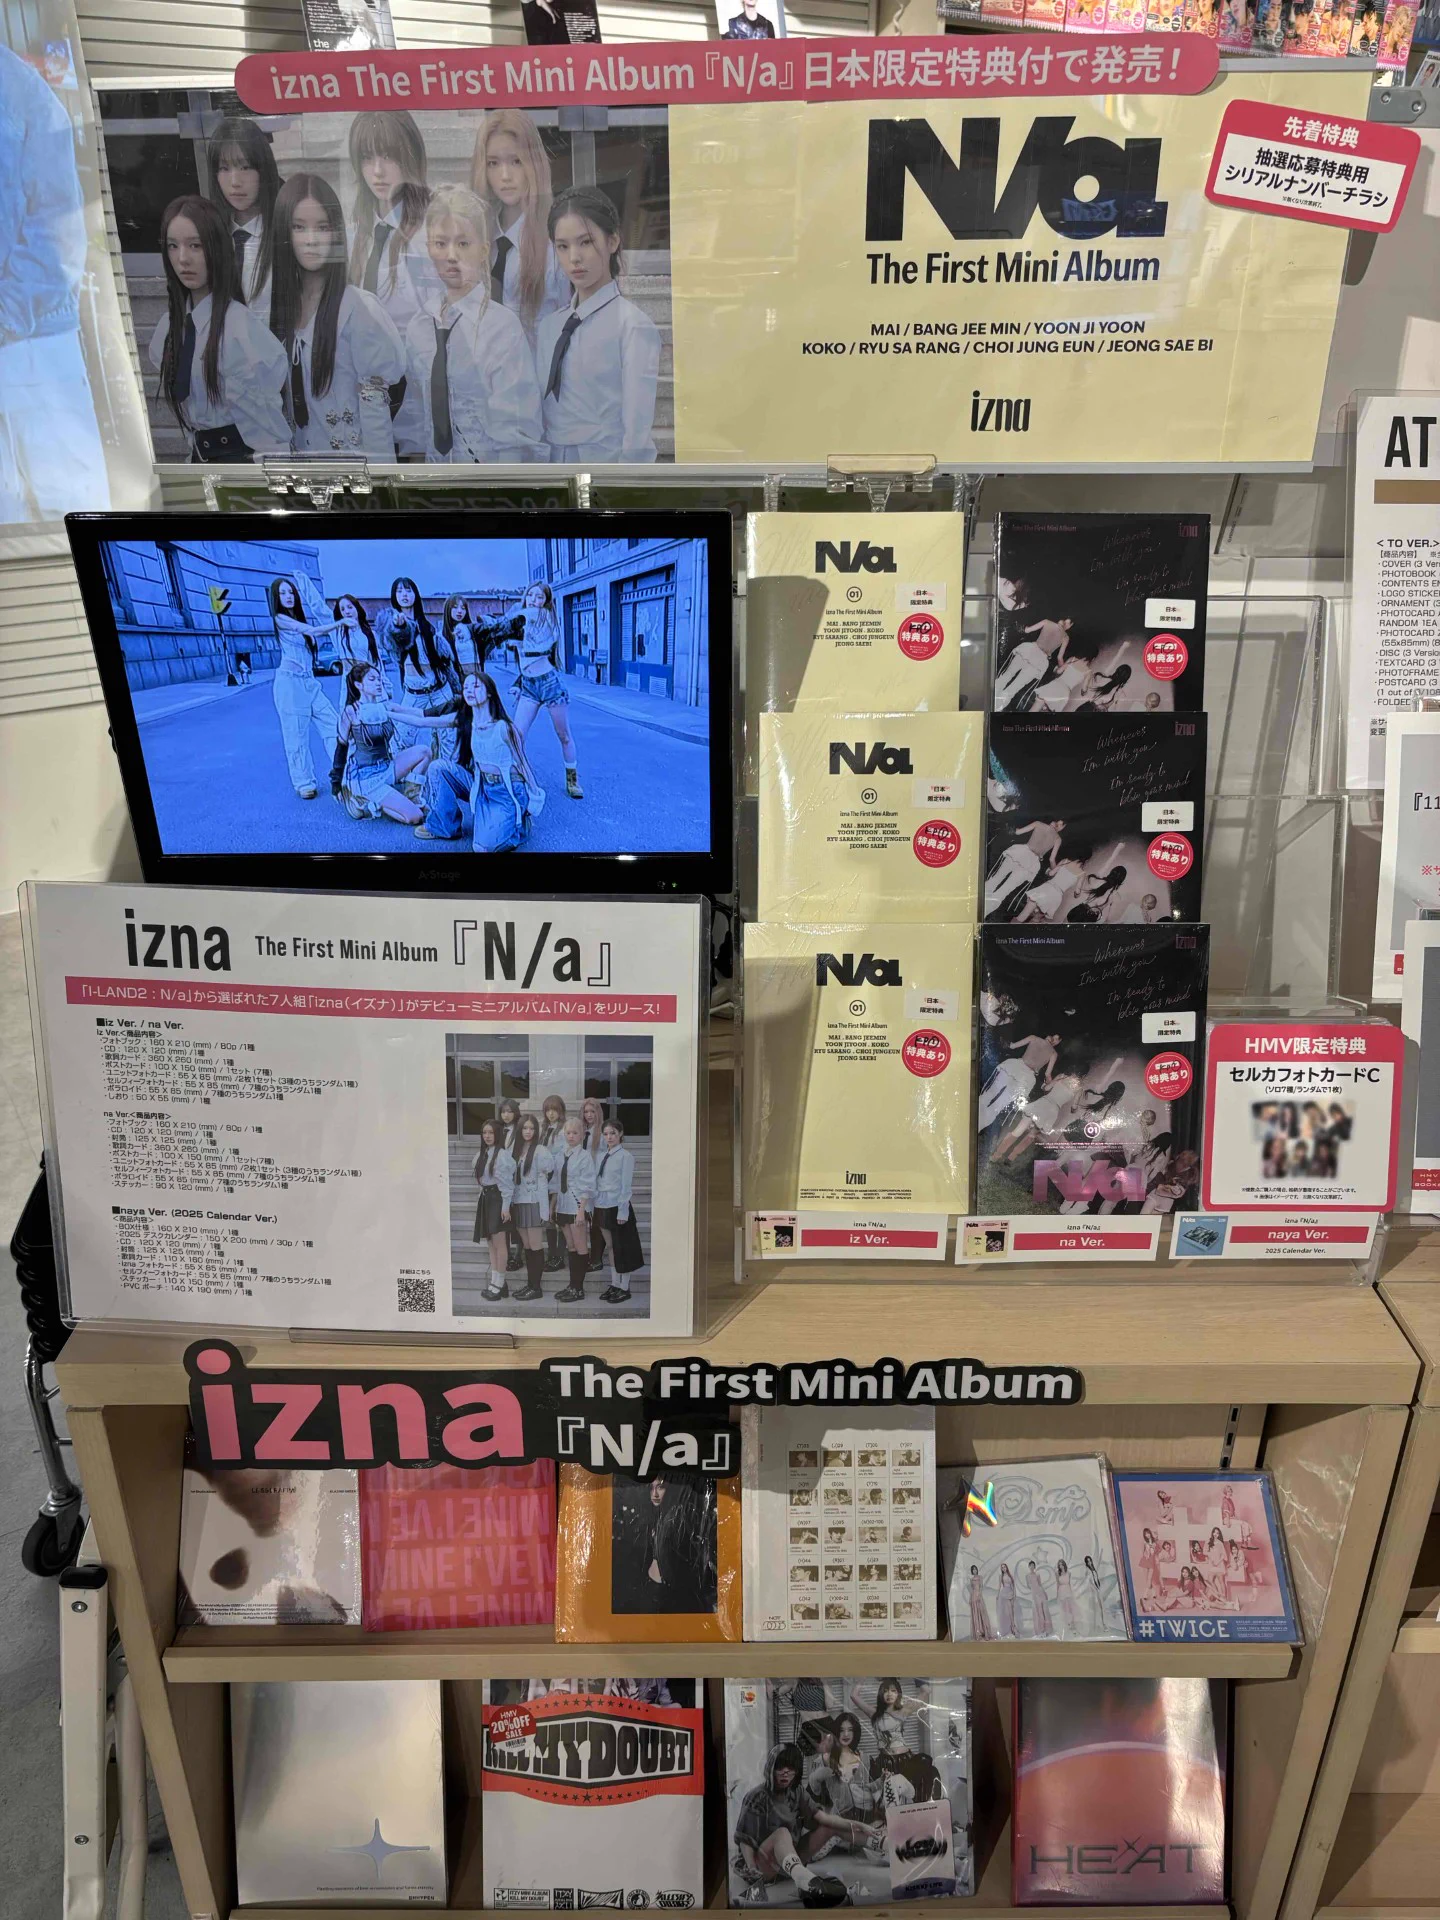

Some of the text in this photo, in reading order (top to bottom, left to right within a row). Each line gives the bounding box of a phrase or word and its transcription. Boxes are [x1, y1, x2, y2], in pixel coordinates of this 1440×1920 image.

[313, 38, 330, 49] the
[270, 66, 340, 101] izna
[346, 62, 411, 98] The
[419, 60, 496, 96] First
[504, 57, 576, 93] Mini
[584, 55, 694, 92] Album
[1282, 116, 1361, 149] 先着特典
[1254, 147, 1370, 184] 抽選応募特典用
[865, 115, 1168, 243] N/a
[1225, 164, 1389, 209] シリアルナンバーチラシ
[866, 248, 1160, 285] The First Mini Album
[870, 320, 1145, 336] MAI / BANG JEE MIN / YOON JI YOON
[802, 339, 1213, 355] KOKO / RYU SA RANG / CHOI JUNG EUN / JEONG SAE BI
[970, 390, 1031, 432] izna
[1387, 539, 1403, 548] TO
[815, 540, 897, 573] N/a
[849, 590, 860, 598] 01
[1379, 619, 1418, 627] RANDOM
[901, 631, 940, 644] 特典あり
[1147, 653, 1184, 664] 特典あり
[829, 742, 913, 775] N/a
[864, 792, 874, 800] 01
[917, 835, 956, 853] 特典あり
[1150, 848, 1189, 865] 特典あり
[418, 869, 461, 880] A-Stage
[125, 908, 610, 989] izna The First Mini Album 『N/a』
[1008, 937, 1065, 945] The First Mini Album
[816, 953, 903, 987] N/a
[852, 1004, 863, 1012] 01
[117, 1018, 137, 1028] Ver.
[140, 1019, 145, 1028] /
[148, 1021, 161, 1029] na
[164, 1020, 184, 1030] Ver.
[1163, 1019, 1176, 1027] 日本
[906, 1045, 946, 1062] 特典あり
[1244, 1036, 1367, 1056] HMV限定特典
[1148, 1069, 1189, 1085] 特典あり
[1229, 1066, 1380, 1083] セルカフォトカードC
[1087, 1126, 1098, 1134] 01
[846, 1170, 867, 1185] izna
[1033, 1159, 1146, 1202] N/a
[148, 1207, 167, 1217] Ver.
[171, 1208, 203, 1220] (2025
[206, 1210, 252, 1222] Calendar
[255, 1213, 278, 1225] Ver.)
[850, 1233, 890, 1244] iz Ver.
[1059, 1236, 1105, 1247] na Ver.
[1267, 1229, 1330, 1242] naya Ver.
[549, 1362, 1073, 1400] The First Mini Album
[197, 1348, 525, 1461] izna
[556, 1415, 730, 1476] 『N/a』
[369, 1546, 456, 1593] MINE
[1139, 1619, 1231, 1638] #TWICE
[500, 1708, 517, 1719] HMV
[505, 1728, 523, 1739] SALE
[590, 1720, 689, 1779] DOUBT
